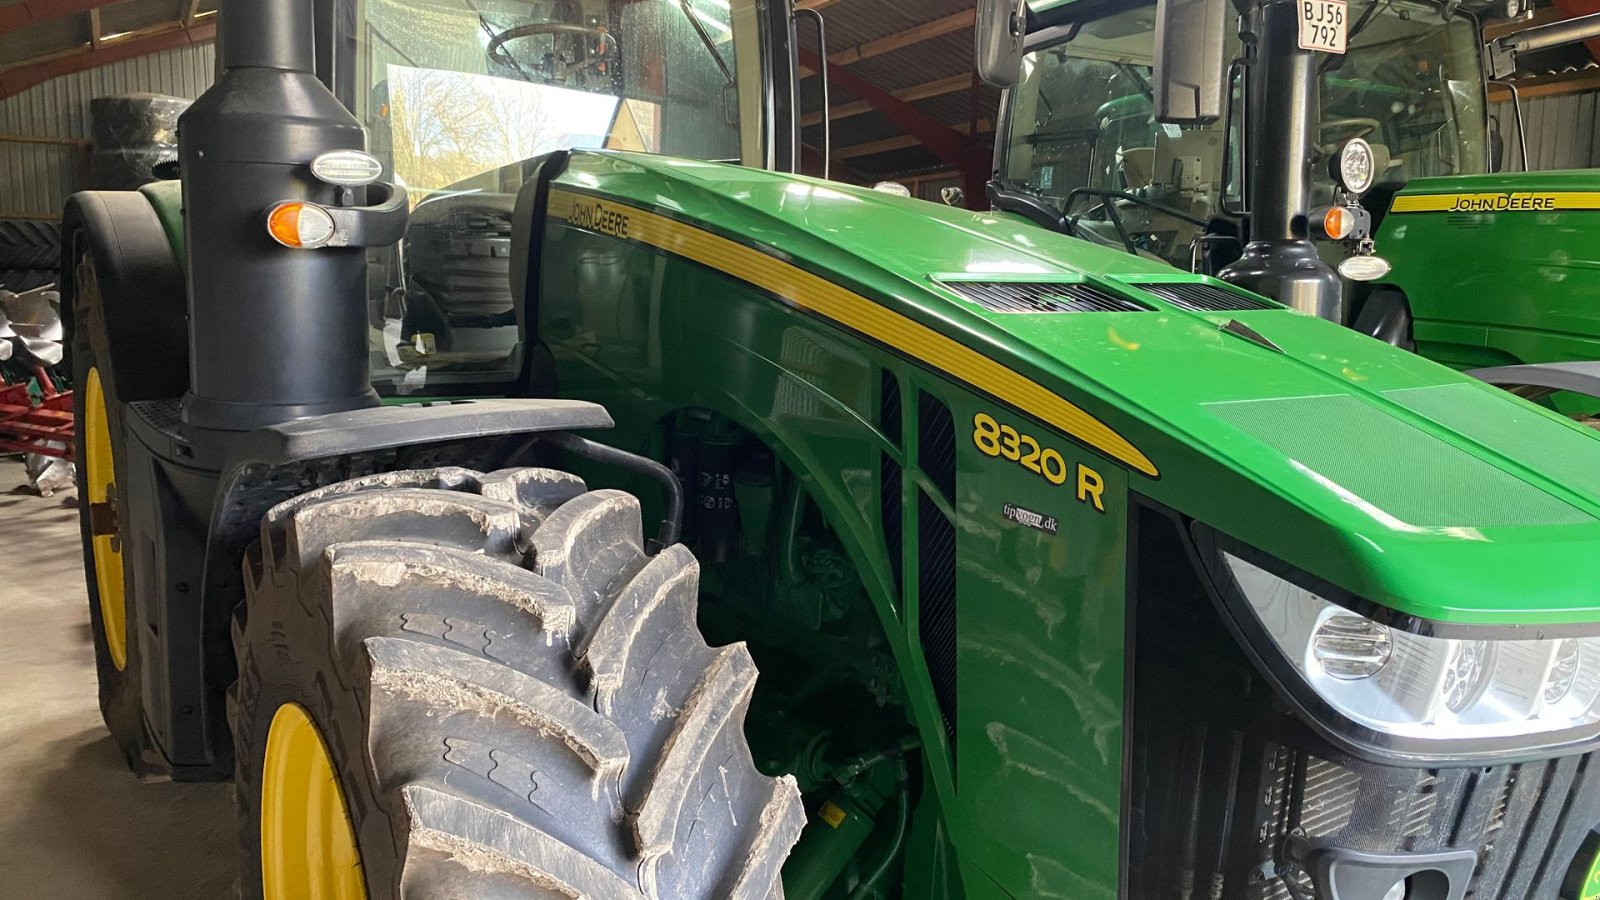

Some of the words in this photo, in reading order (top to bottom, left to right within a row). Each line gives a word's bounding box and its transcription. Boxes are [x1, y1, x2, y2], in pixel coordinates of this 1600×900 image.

[1304, 1, 1342, 25] BJ56
[1311, 24, 1336, 47] 792
[1450, 197, 1494, 210] JOHN
[1497, 196, 1555, 209] DEERE
[568, 200, 594, 228] JOHN
[595, 204, 629, 236] DEERE
[973, 412, 1067, 485] 8320
[1077, 463, 1104, 512] R
